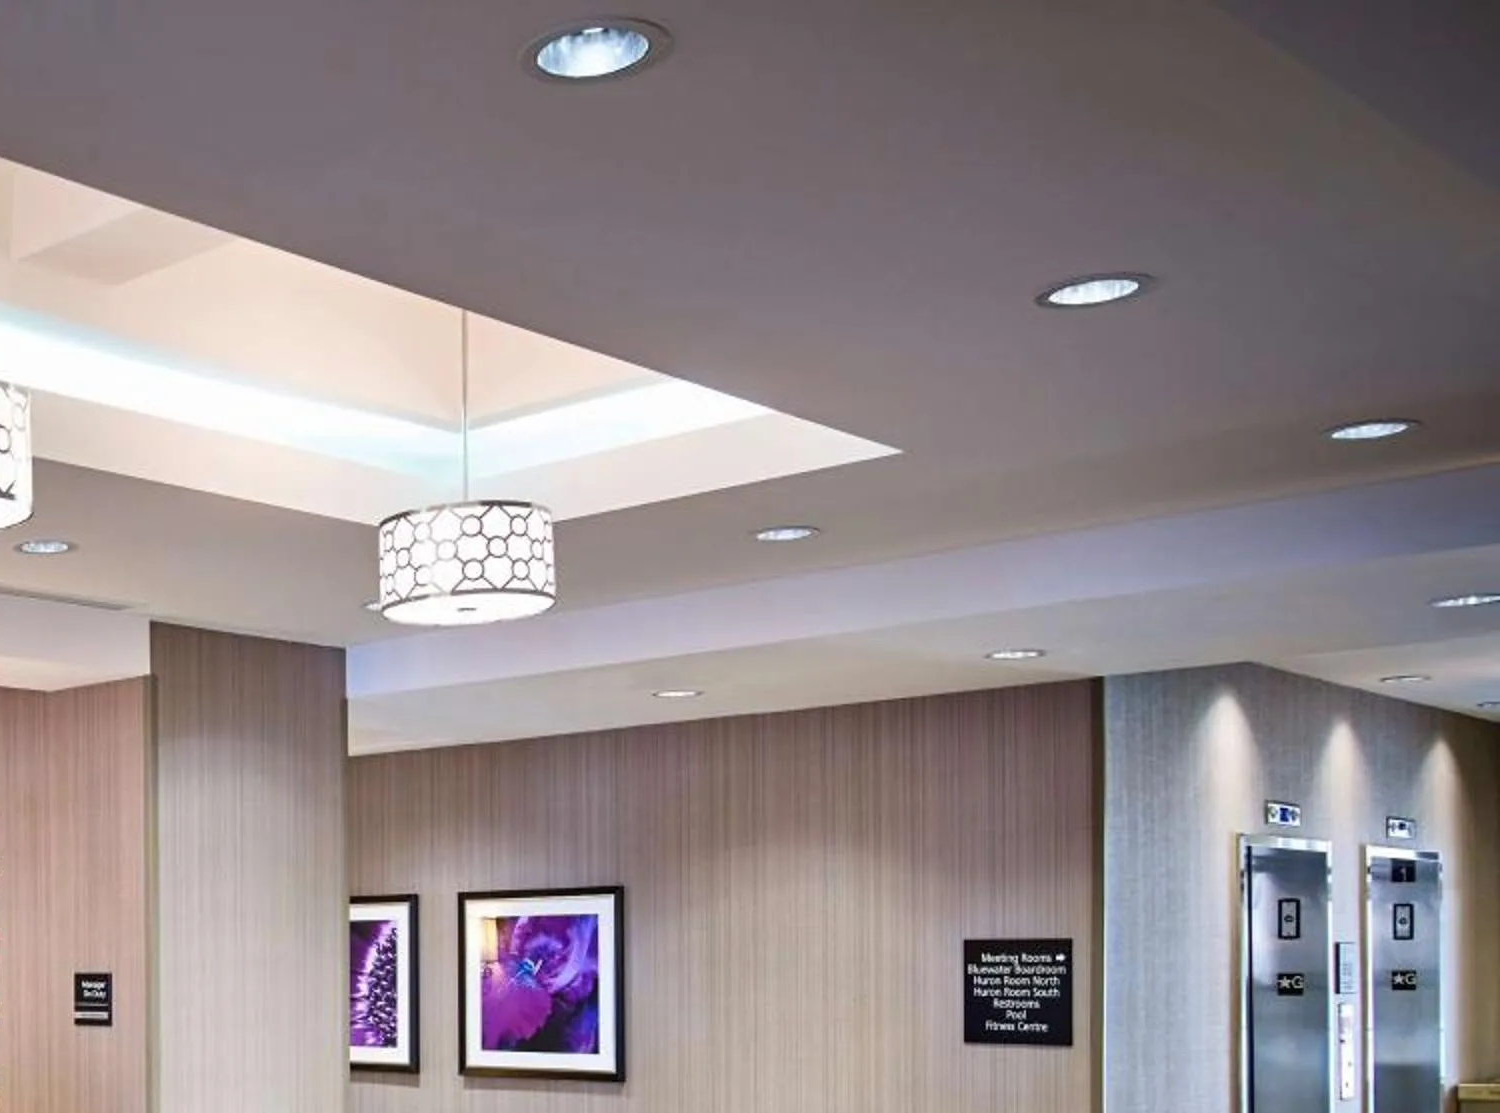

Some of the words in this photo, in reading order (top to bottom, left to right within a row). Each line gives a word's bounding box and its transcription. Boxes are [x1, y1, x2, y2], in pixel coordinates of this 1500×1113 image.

[1021, 953, 1052, 963] Rooms
[1014, 965, 1067, 975] Boardroom
[973, 975, 1002, 985] Huron
[1003, 975, 1031, 985] Room
[1032, 976, 1061, 986] North
[1291, 975, 1304, 989] G
[1405, 973, 1417, 985] G
[973, 987, 1002, 997] Huron
[1003, 987, 1031, 997] Room
[1033, 988, 1061, 997] South
[993, 998, 1041, 1009] Restrooms
[1005, 1010, 1027, 1020] Pool
[1017, 1021, 1049, 1032] Centre
